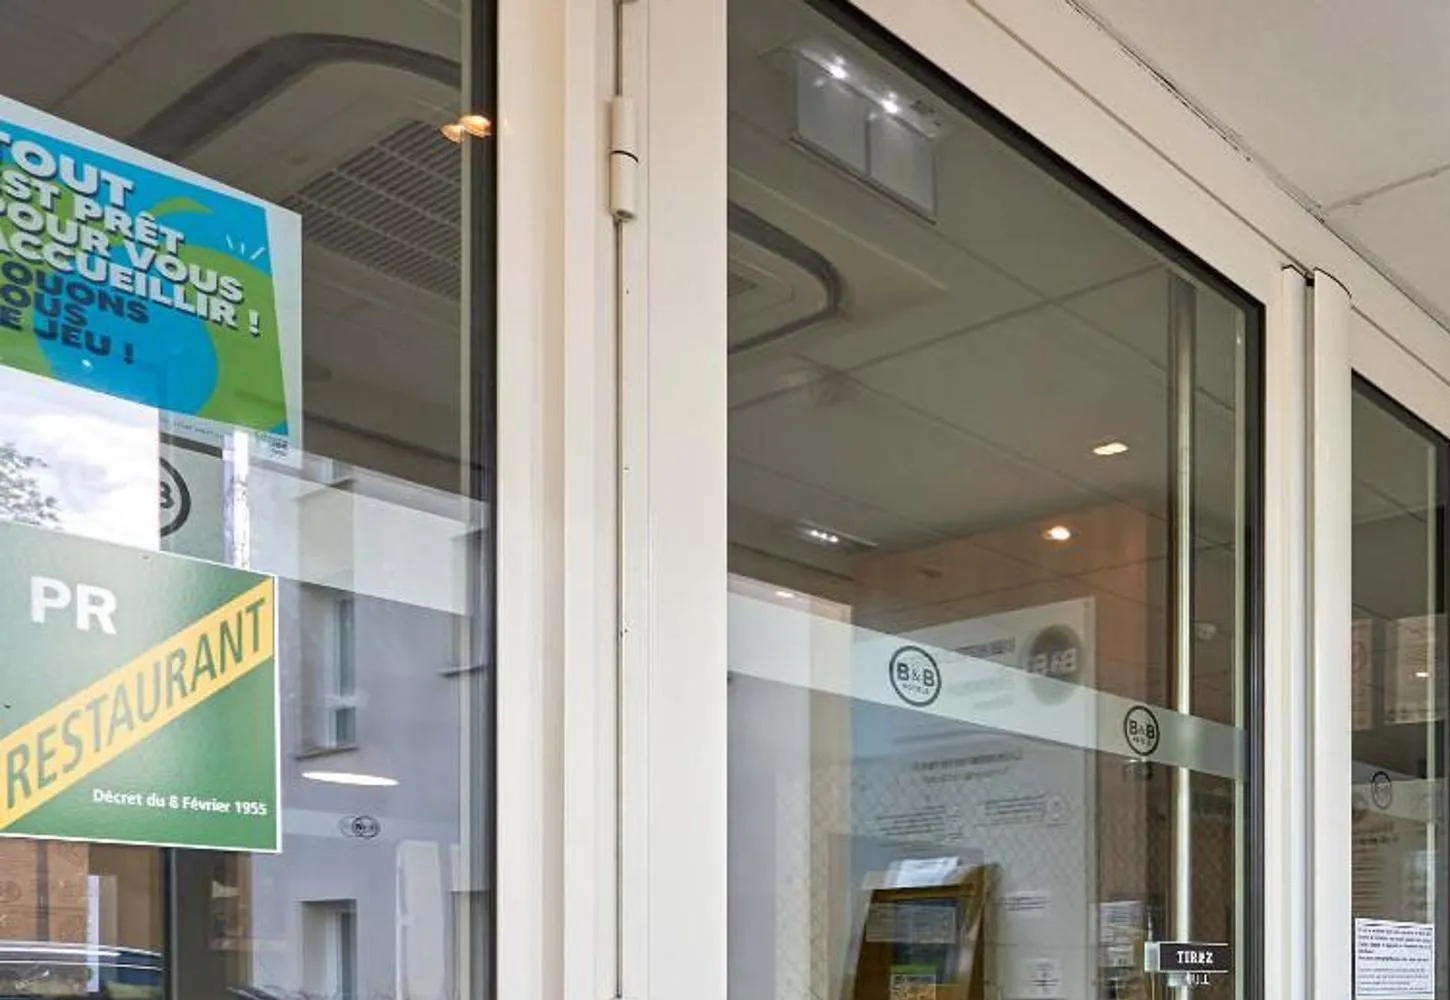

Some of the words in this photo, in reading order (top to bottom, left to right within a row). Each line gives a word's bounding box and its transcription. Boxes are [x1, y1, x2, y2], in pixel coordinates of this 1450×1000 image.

[0, 169, 61, 211] ST
[74, 193, 185, 255] PRÊT
[0, 201, 111, 258] OUR
[123, 238, 245, 303] VOUS
[0, 261, 149, 323] OUONS
[0, 284, 87, 327] OUS
[0, 309, 23, 331] E
[33, 318, 112, 356] JEU
[124, 342, 134, 364] !
[249, 310, 261, 337] !
[30, 576, 118, 635] PR
[7, 597, 269, 810] RESTAURANT
[897, 663, 934, 687] B&B
[93, 789, 142, 807] Décret
[147, 792, 166, 808] du
[169, 795, 179, 810] 8
[182, 796, 232, 814] Février
[235, 800, 268, 816] 1955
